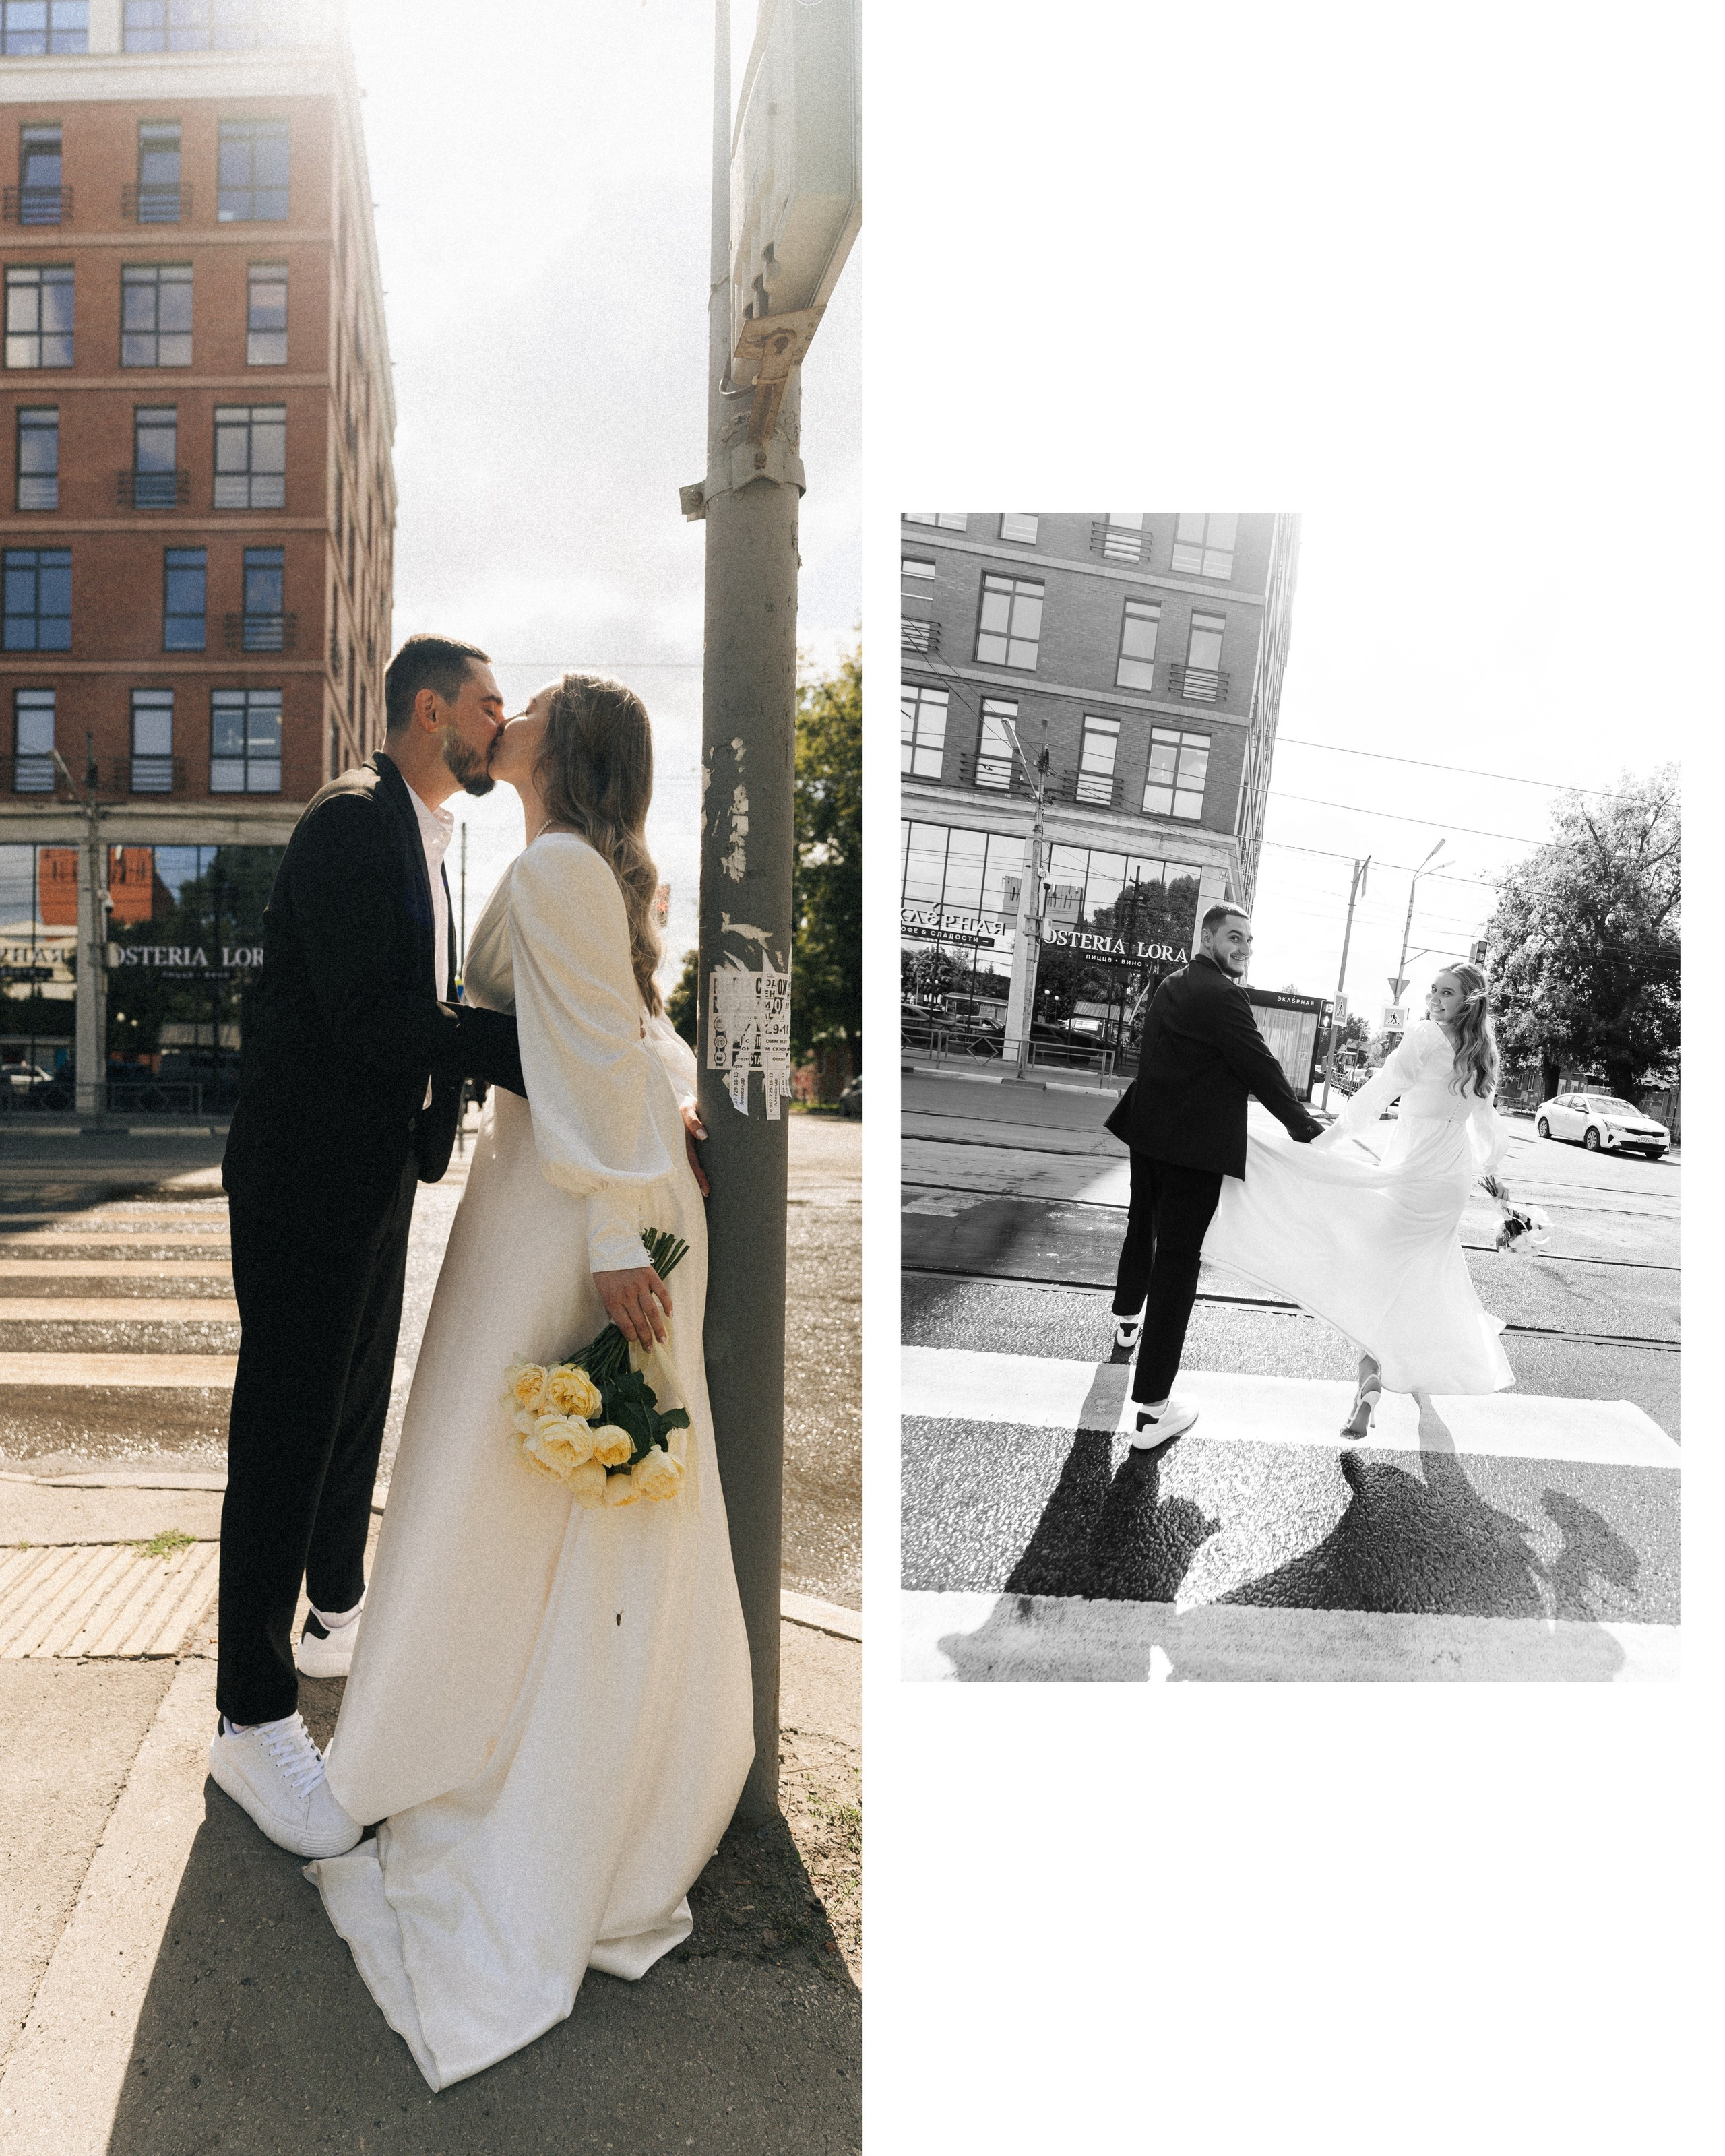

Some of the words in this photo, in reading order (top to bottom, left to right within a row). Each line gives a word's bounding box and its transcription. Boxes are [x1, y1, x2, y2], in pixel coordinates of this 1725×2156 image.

[930, 930, 978, 943] СЛАДОСТИ
[222, 946, 263, 966] LOR
[1137, 941, 1189, 963] LORA
[1086, 954, 1112, 963] пицца
[1121, 959, 1142, 968] вино
